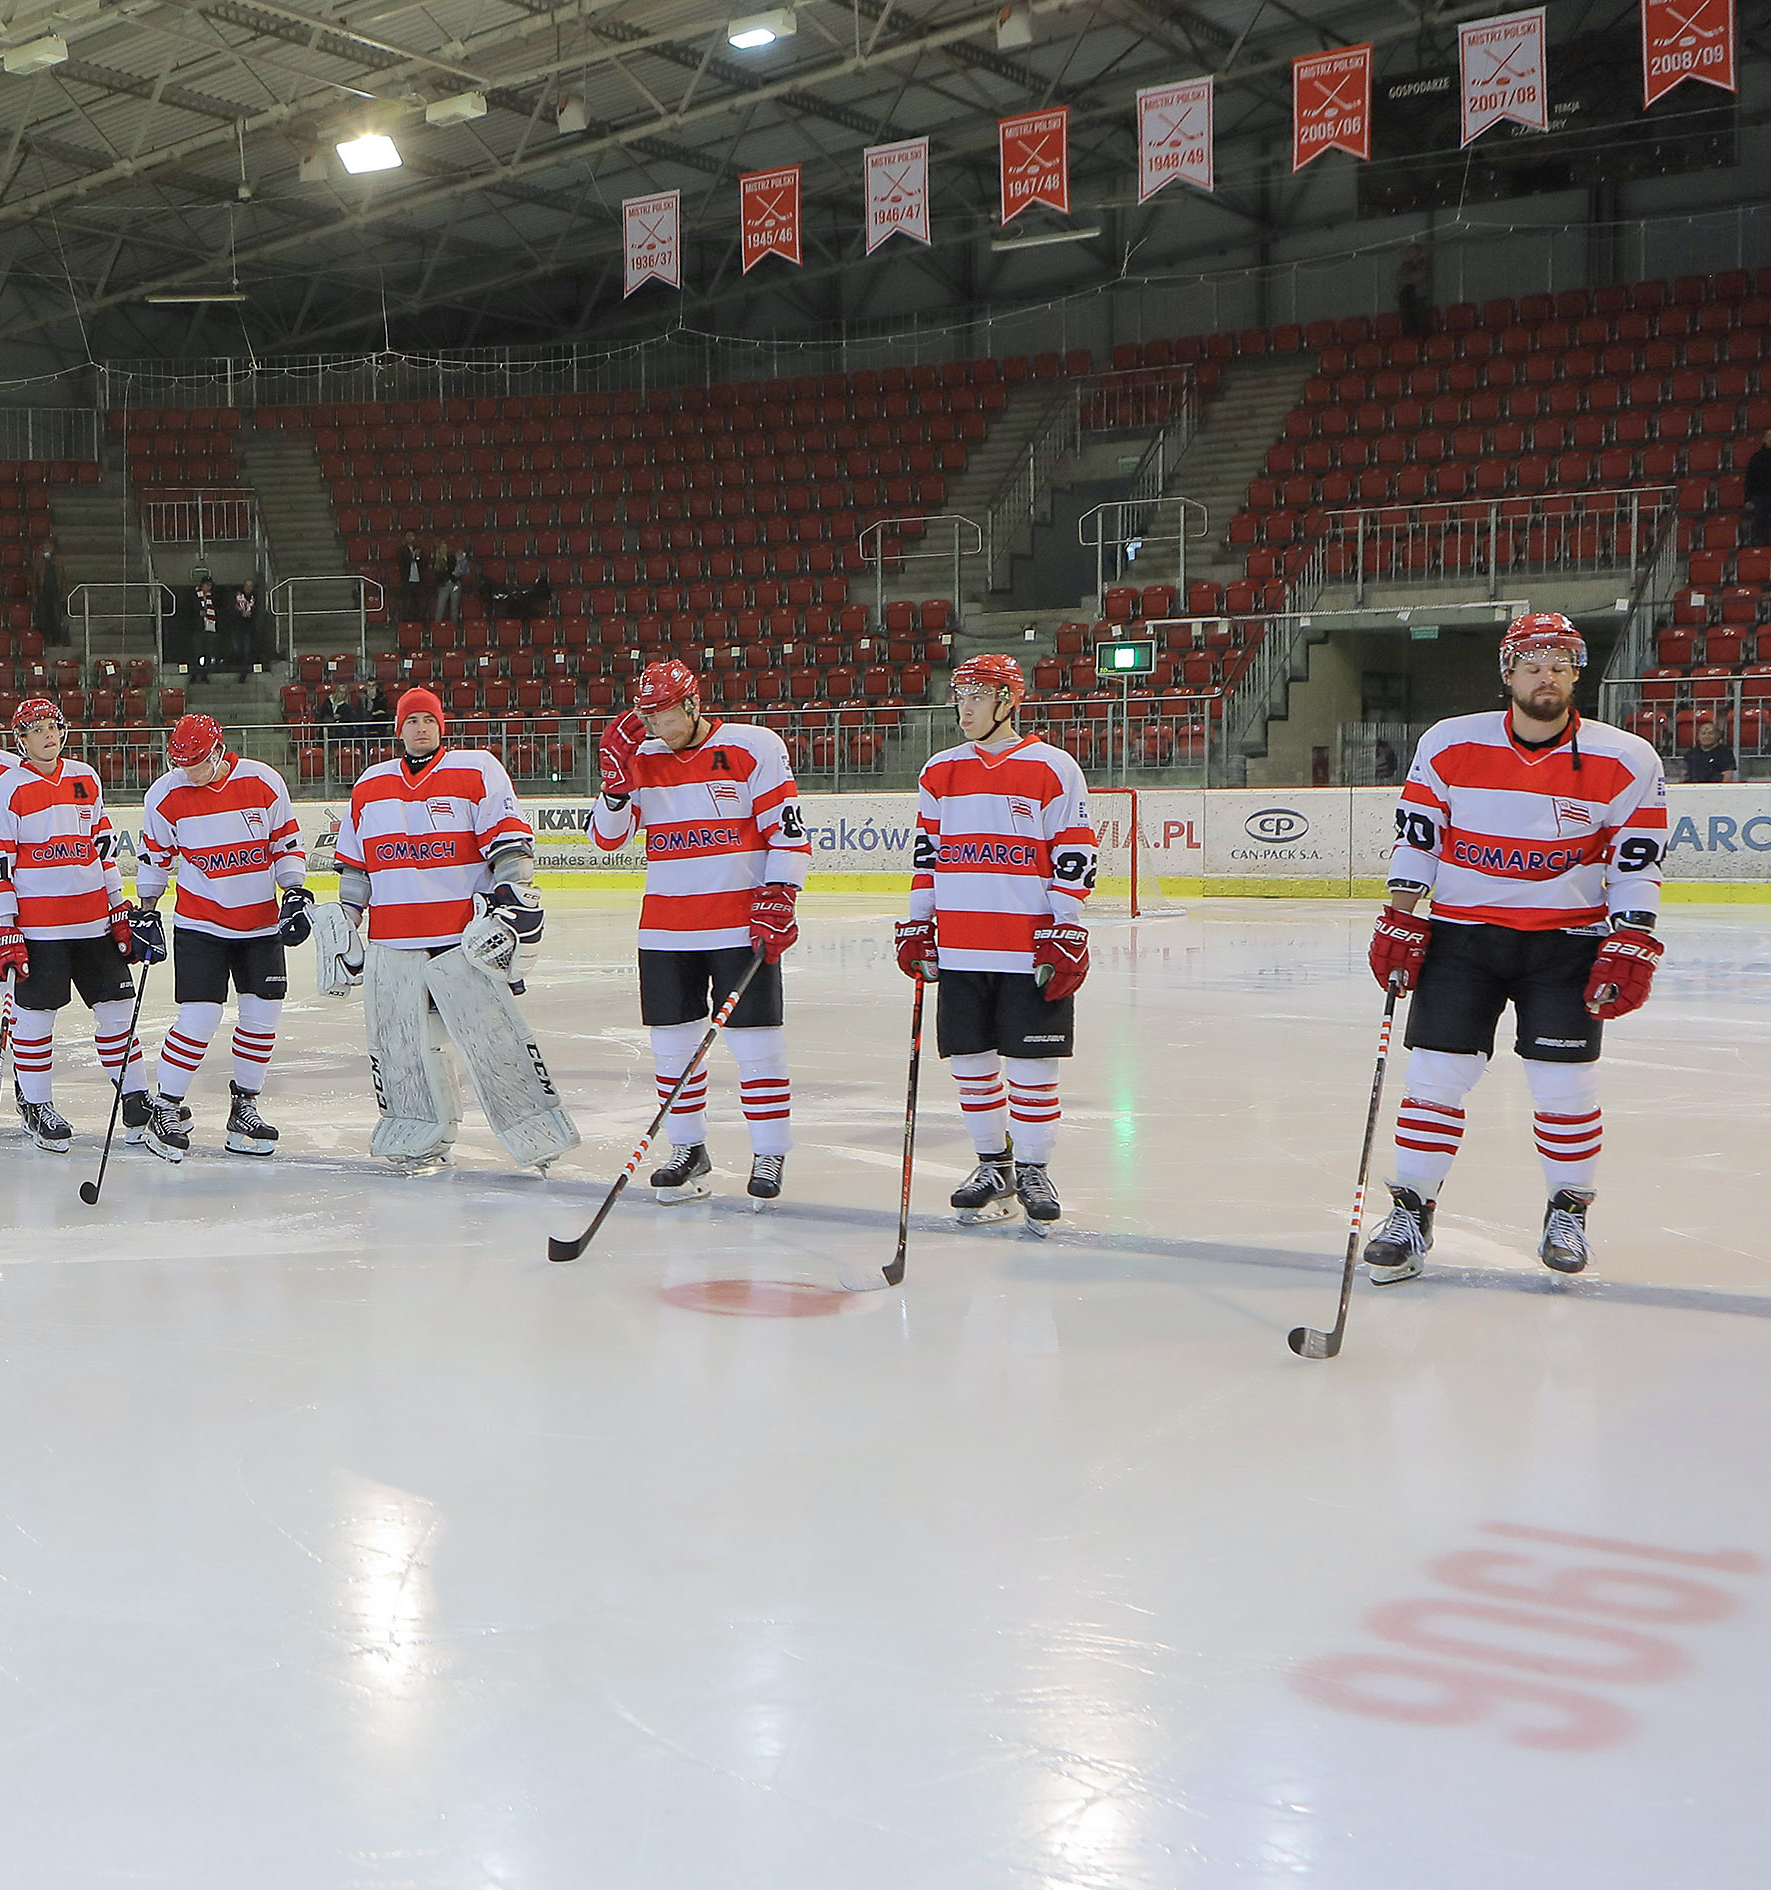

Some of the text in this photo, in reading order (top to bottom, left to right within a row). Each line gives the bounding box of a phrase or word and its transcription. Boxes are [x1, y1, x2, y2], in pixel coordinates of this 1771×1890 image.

[1467, 22, 1537, 47] MISTRZ POLSKI
[1300, 56, 1364, 81] MISTRZ POLSKI
[1650, 44, 1725, 76] 2008/09
[1388, 76, 1450, 100] GOSPODARZE
[1469, 85, 1537, 113] 2007/08
[1005, 117, 1062, 139] MISTRZ POLSKI
[871, 150, 922, 168] MISTRZ POLSKI
[745, 175, 795, 193] MISTRZ POLSKI
[1009, 173, 1060, 198] 1947/48
[629, 201, 674, 217] MISTRZ POLSKI
[874, 203, 921, 225] 1946/47
[747, 227, 793, 248] 1945/46
[631, 251, 673, 270] 1936/37
[711, 751, 731, 770] A
[74, 782, 89, 799] A
[807, 817, 910, 851] raków
[377, 841, 455, 861] COMARCH
[538, 853, 648, 866] makes a differe
[938, 843, 1038, 866] COMARCH
[1231, 849, 1323, 860] CAN-PACK S.A.
[1454, 840, 1584, 872] COMARCH
[1616, 837, 1668, 872] 9
[751, 901, 793, 913] AUER
[129, 920, 153, 928] CM
[896, 924, 929, 937] UER
[1033, 928, 1088, 942] BAUER
[1374, 919, 1425, 944] AUER
[526, 1042, 555, 1096] CCM
[369, 1054, 388, 1110] CCM
